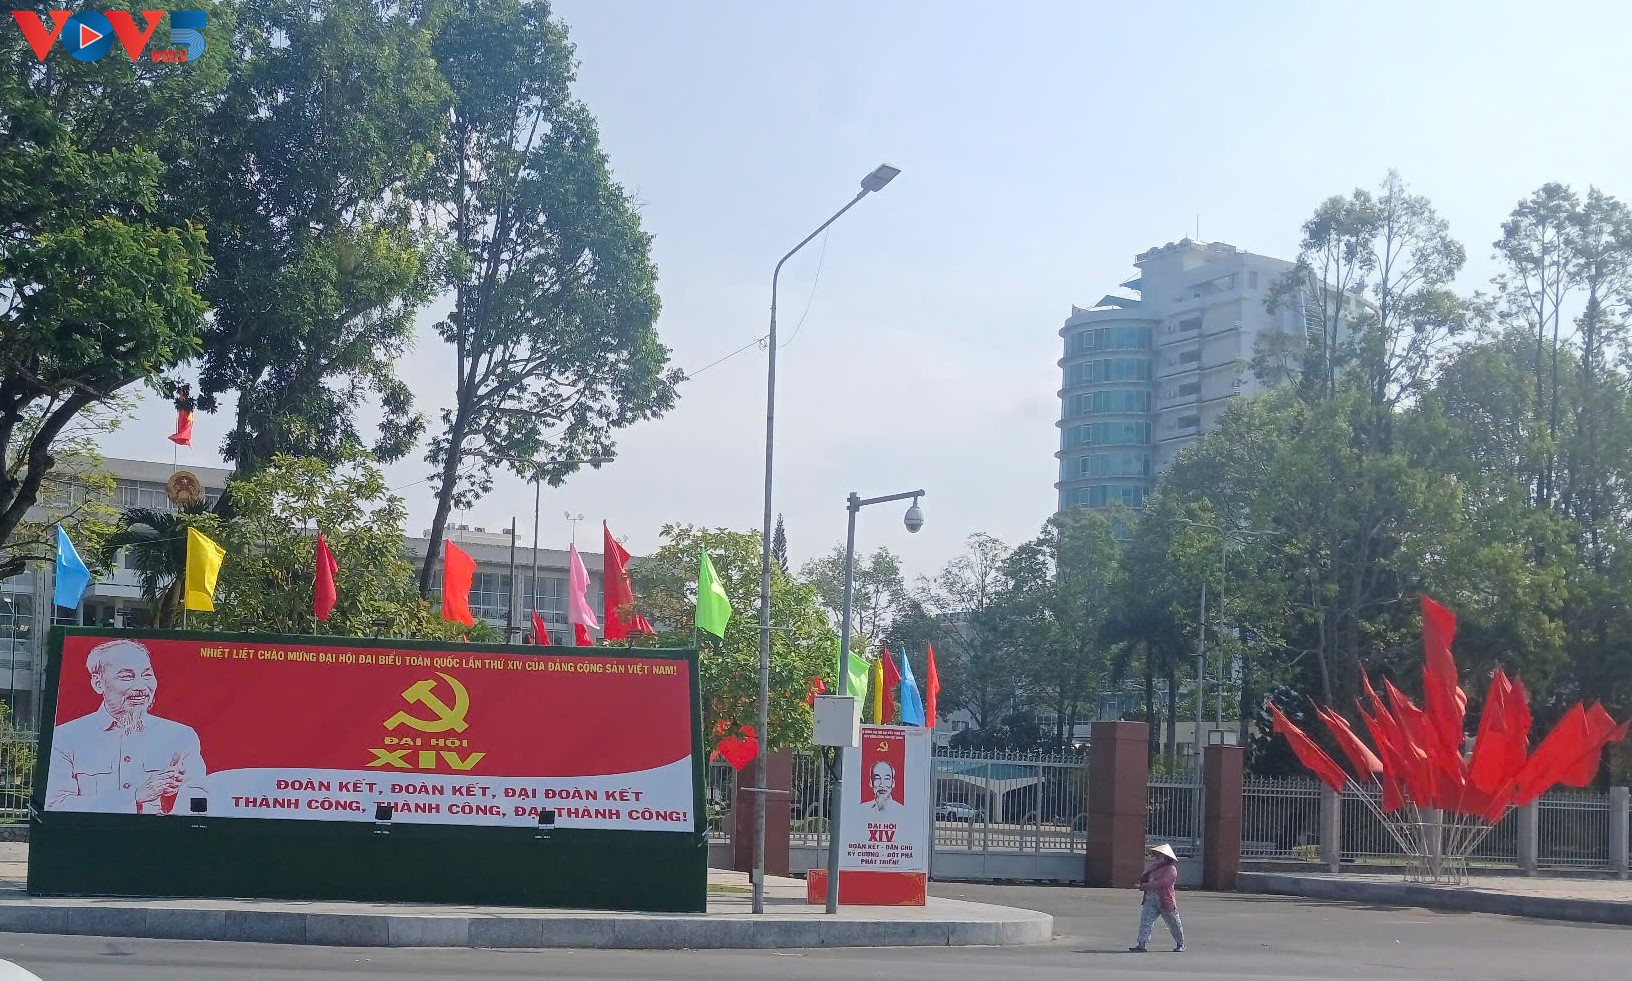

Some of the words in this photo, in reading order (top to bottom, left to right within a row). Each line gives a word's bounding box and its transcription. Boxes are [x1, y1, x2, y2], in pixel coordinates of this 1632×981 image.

[200, 646, 230, 660] NHIỆT
[232, 647, 255, 661] LIỆT
[257, 648, 285, 661] CHÀO
[287, 650, 317, 662] MỪNG
[319, 652, 336, 664] ĐẠI
[338, 652, 356, 665] HỘI
[358, 654, 376, 666] ĐẠI
[378, 650, 402, 665] BIỂU
[405, 655, 431, 667] TOÀN
[433, 654, 460, 668] QUỐC
[462, 656, 482, 669] LẦN
[484, 658, 505, 670] THỨ
[507, 660, 523, 670] XIV
[525, 658, 546, 671] CỦA
[548, 659, 575, 672] ĐẢNG
[576, 661, 603, 674] CỘNG
[605, 661, 625, 674] SẢN
[627, 662, 650, 676] VIỆT
[652, 665, 678, 676] NAM!
[384, 736, 422, 747] ĐẠI
[430, 737, 468, 748] HỘI
[364, 748, 487, 771] XIV
[275, 778, 331, 792] ĐOÀN
[338, 778, 384, 796] KẾT,
[390, 782, 445, 796] ĐOÀN
[451, 782, 497, 800] KẾT,
[503, 787, 537, 801] ĐẠI
[544, 786, 598, 801] ĐOÀN
[605, 787, 644, 802] KẾT
[231, 796, 300, 810] THÀNH
[306, 797, 367, 814] CÔNG,
[448, 802, 507, 819] CÔNG,
[554, 804, 621, 820] THÀNH
[627, 807, 688, 823] CÔNG!
[867, 822, 881, 830] ĐẠI
[883, 822, 897, 830] HỘI
[867, 829, 896, 842] XIV
[868, 842, 880, 850] KẾT
